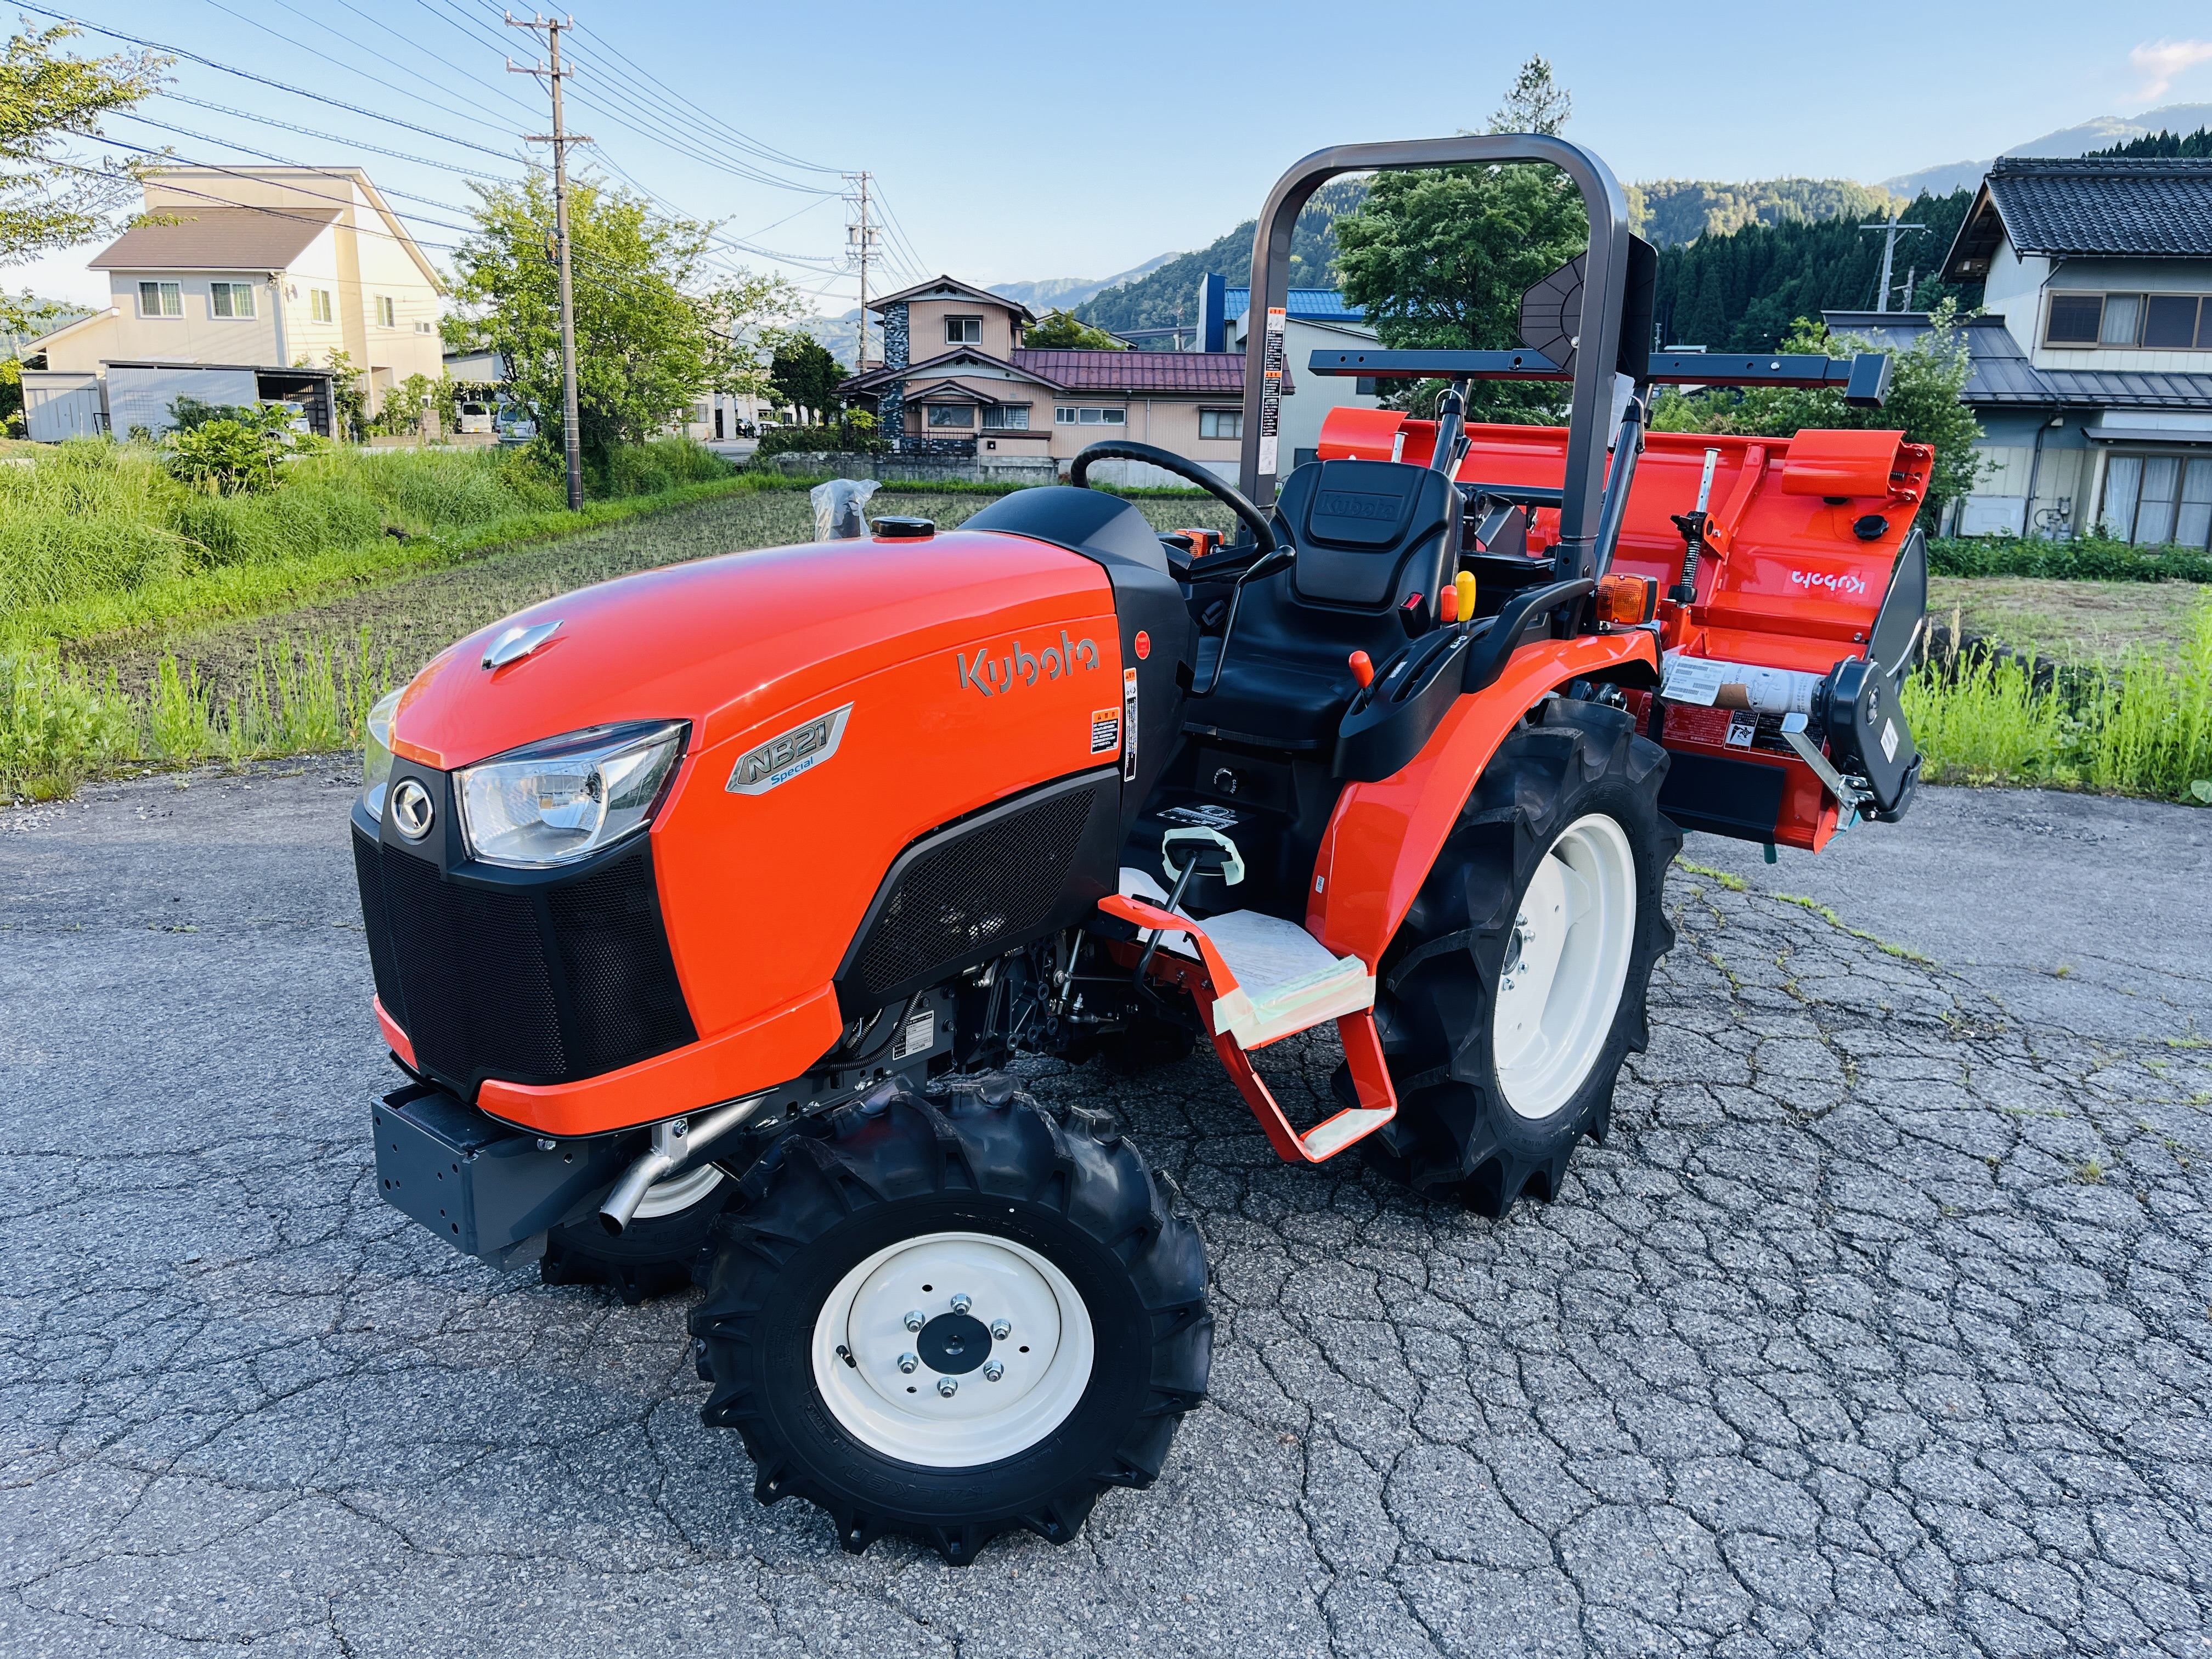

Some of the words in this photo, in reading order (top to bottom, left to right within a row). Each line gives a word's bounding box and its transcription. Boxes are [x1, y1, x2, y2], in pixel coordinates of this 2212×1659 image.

[1322, 494, 1395, 518] Kubota
[1791, 570, 1865, 595] Kubota
[1449, 635, 1468, 649] PTO
[957, 630, 1098, 697] Kubota
[747, 721, 827, 782] NB21
[771, 756, 814, 786] Special
[844, 1462, 985, 1505] FALKEN
